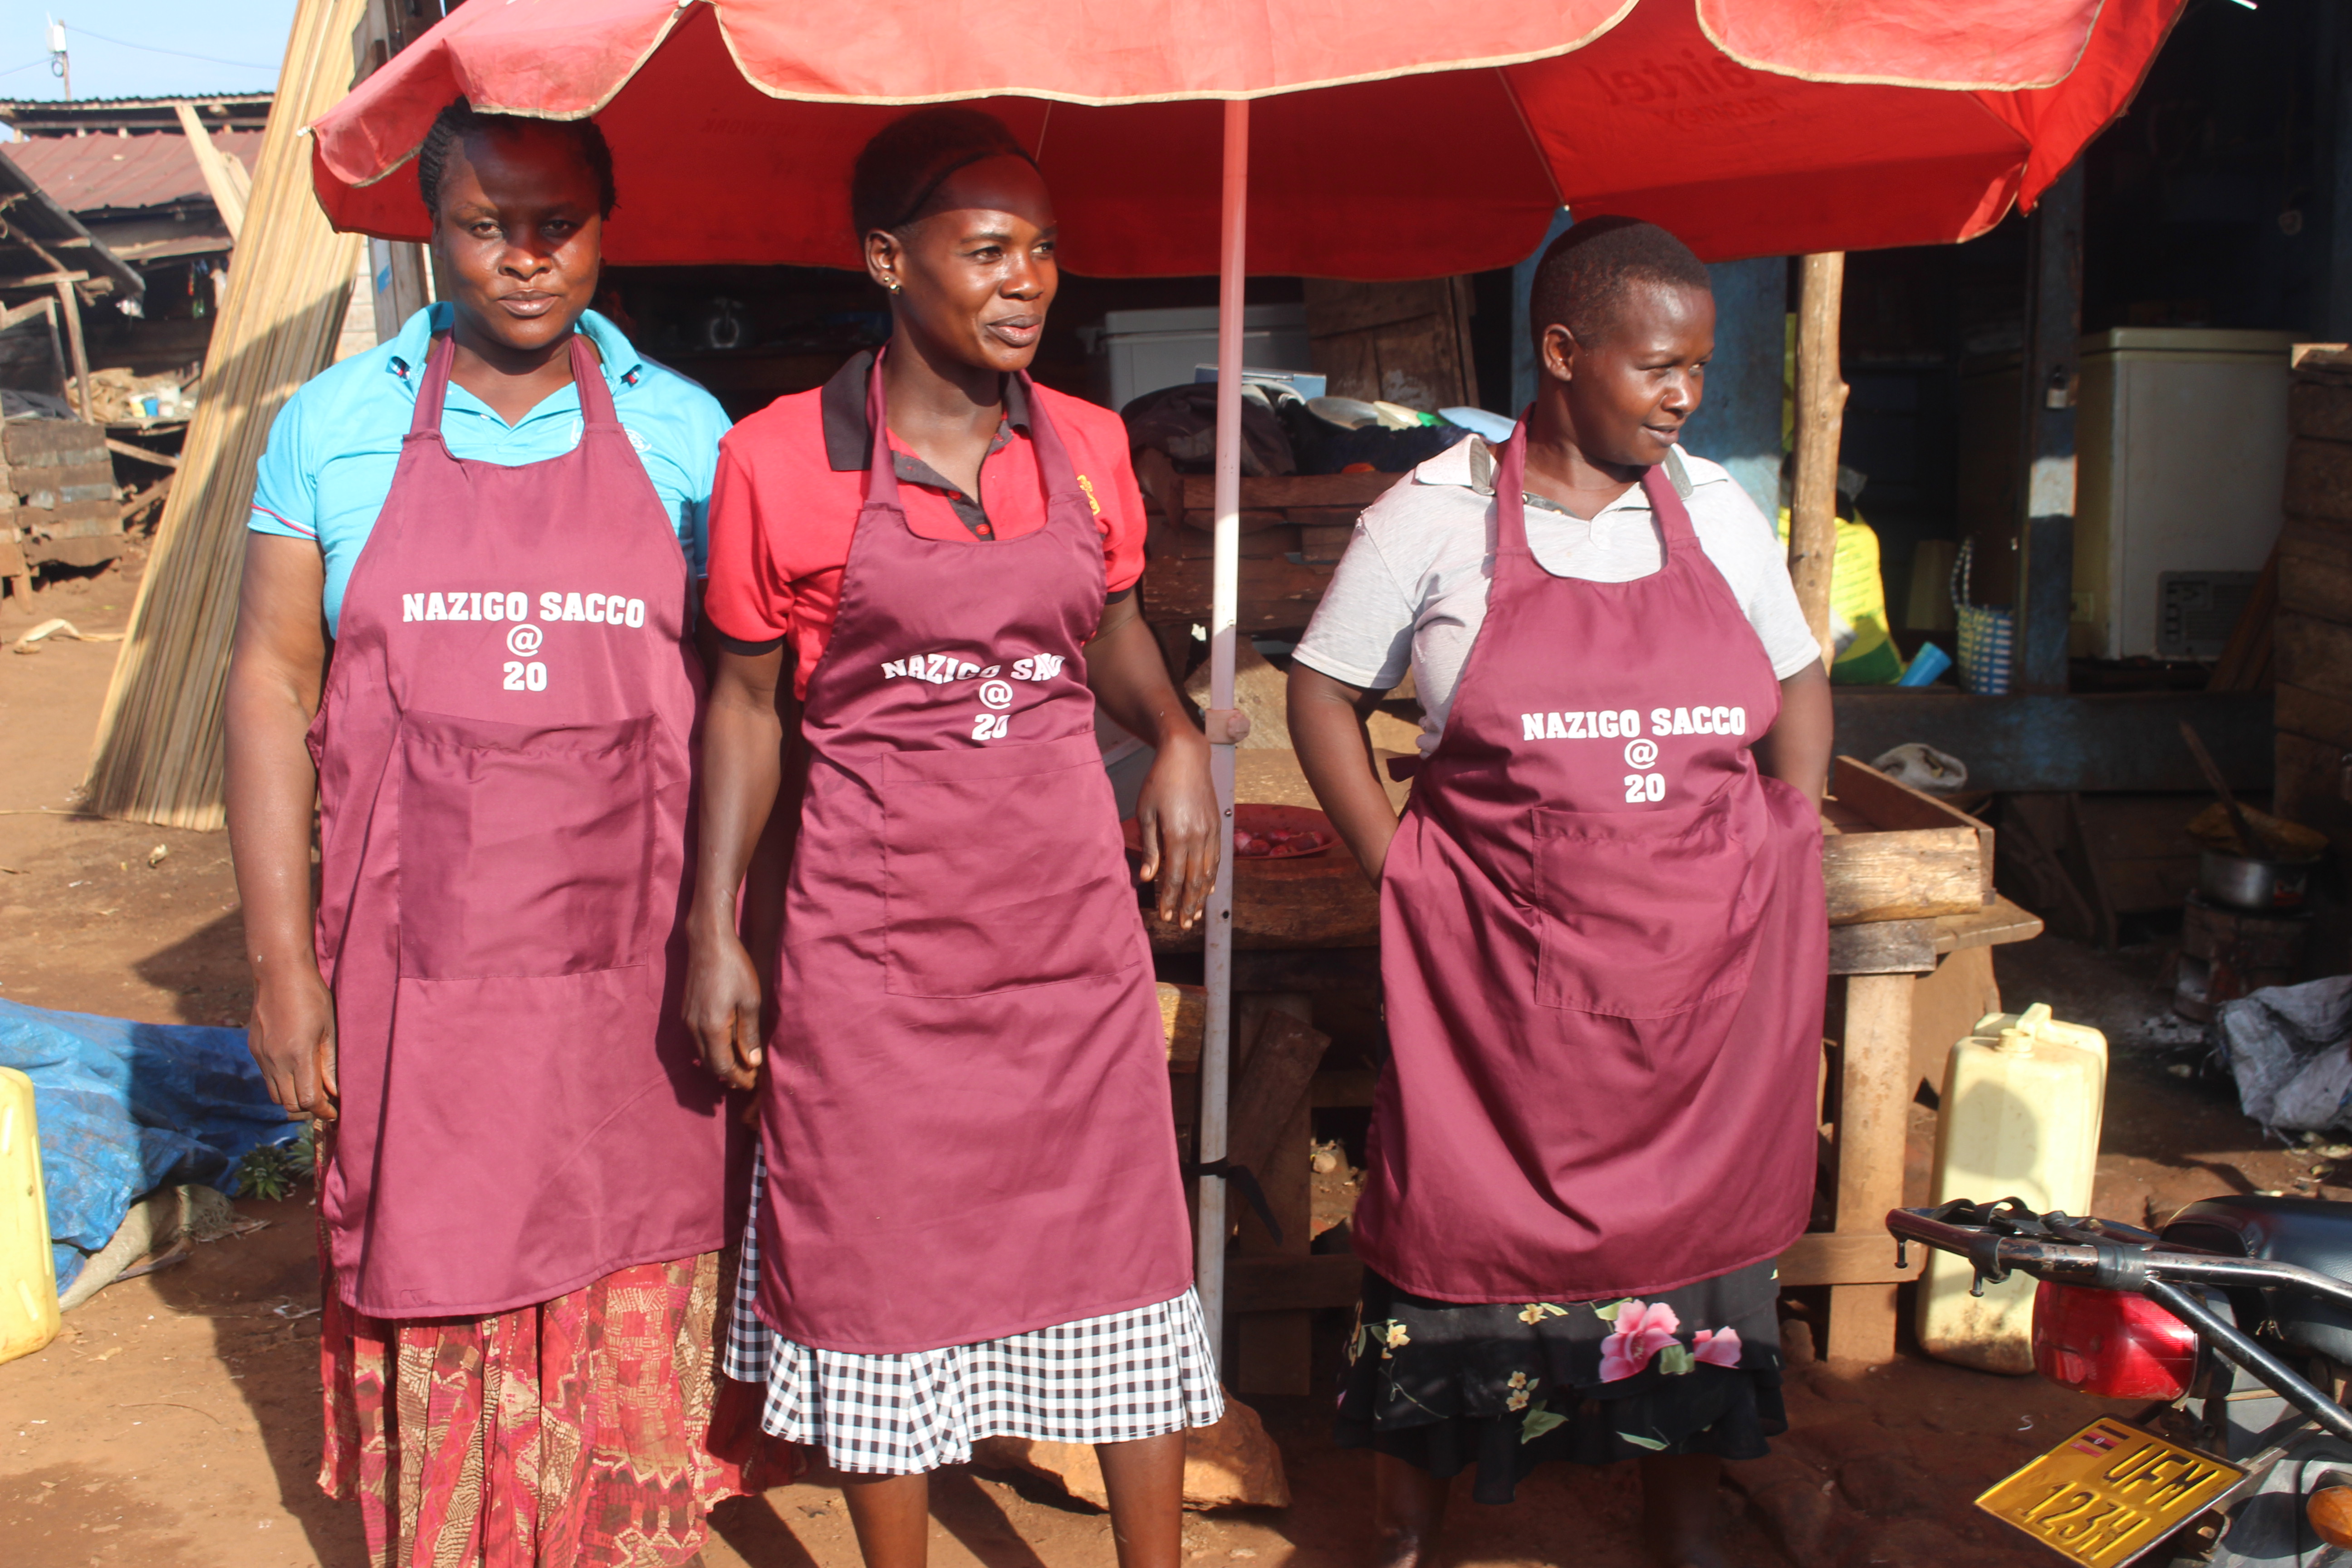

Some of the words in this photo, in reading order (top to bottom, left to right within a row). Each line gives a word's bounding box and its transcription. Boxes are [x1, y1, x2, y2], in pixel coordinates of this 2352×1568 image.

[402, 591, 529, 622] NAZIGO
[539, 591, 645, 628] SACCO
[506, 623, 543, 657] @
[503, 661, 547, 691] 20
[881, 653, 1001, 685] NAZIGO
[979, 680, 1013, 710] @
[971, 713, 1011, 740] 20
[1521, 709, 1641, 741] NAZIGO
[1650, 706, 1746, 736] SACCO
[1624, 738, 1659, 769] @
[1624, 773, 1666, 803] 20
[2102, 1442, 2221, 1512] UFM
[2015, 1481, 2151, 1561] 123H
